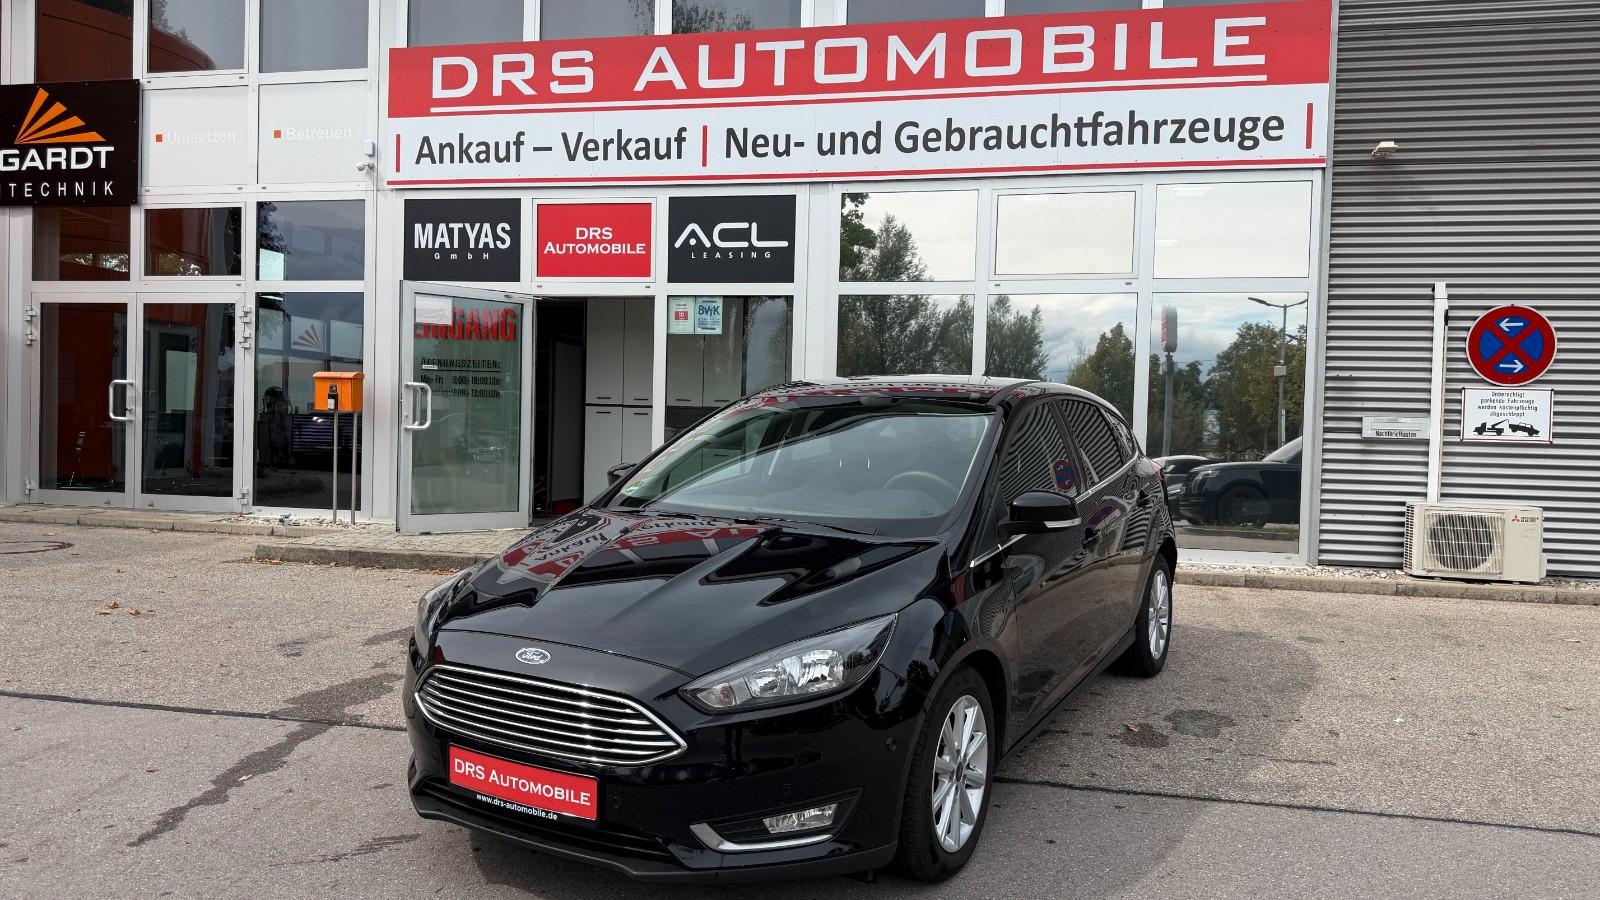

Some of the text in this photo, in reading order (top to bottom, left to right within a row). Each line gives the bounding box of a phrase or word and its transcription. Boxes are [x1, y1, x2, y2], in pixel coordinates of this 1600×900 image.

[432, 16, 1267, 98] DRS AUTOMOBILE
[286, 127, 352, 140] Betreuen
[416, 131, 525, 164] Ankauf
[562, 127, 686, 161] Verkauf
[726, 127, 804, 158] Neu-
[818, 121, 881, 156] und
[895, 110, 1284, 153] Gebrauchtfahrzeuge
[0, 147, 114, 171] GARDT
[0, 181, 113, 198] TECHNIK
[414, 223, 510, 249] MATYAS
[576, 227, 613, 239] DRS
[674, 221, 788, 248] ACL
[544, 242, 646, 255] AUTOMOBILE
[691, 251, 771, 259] LEASING
[454, 758, 591, 806] DRS AUTOMOBILE
[476, 794, 558, 820] www.drs-automobile.de
